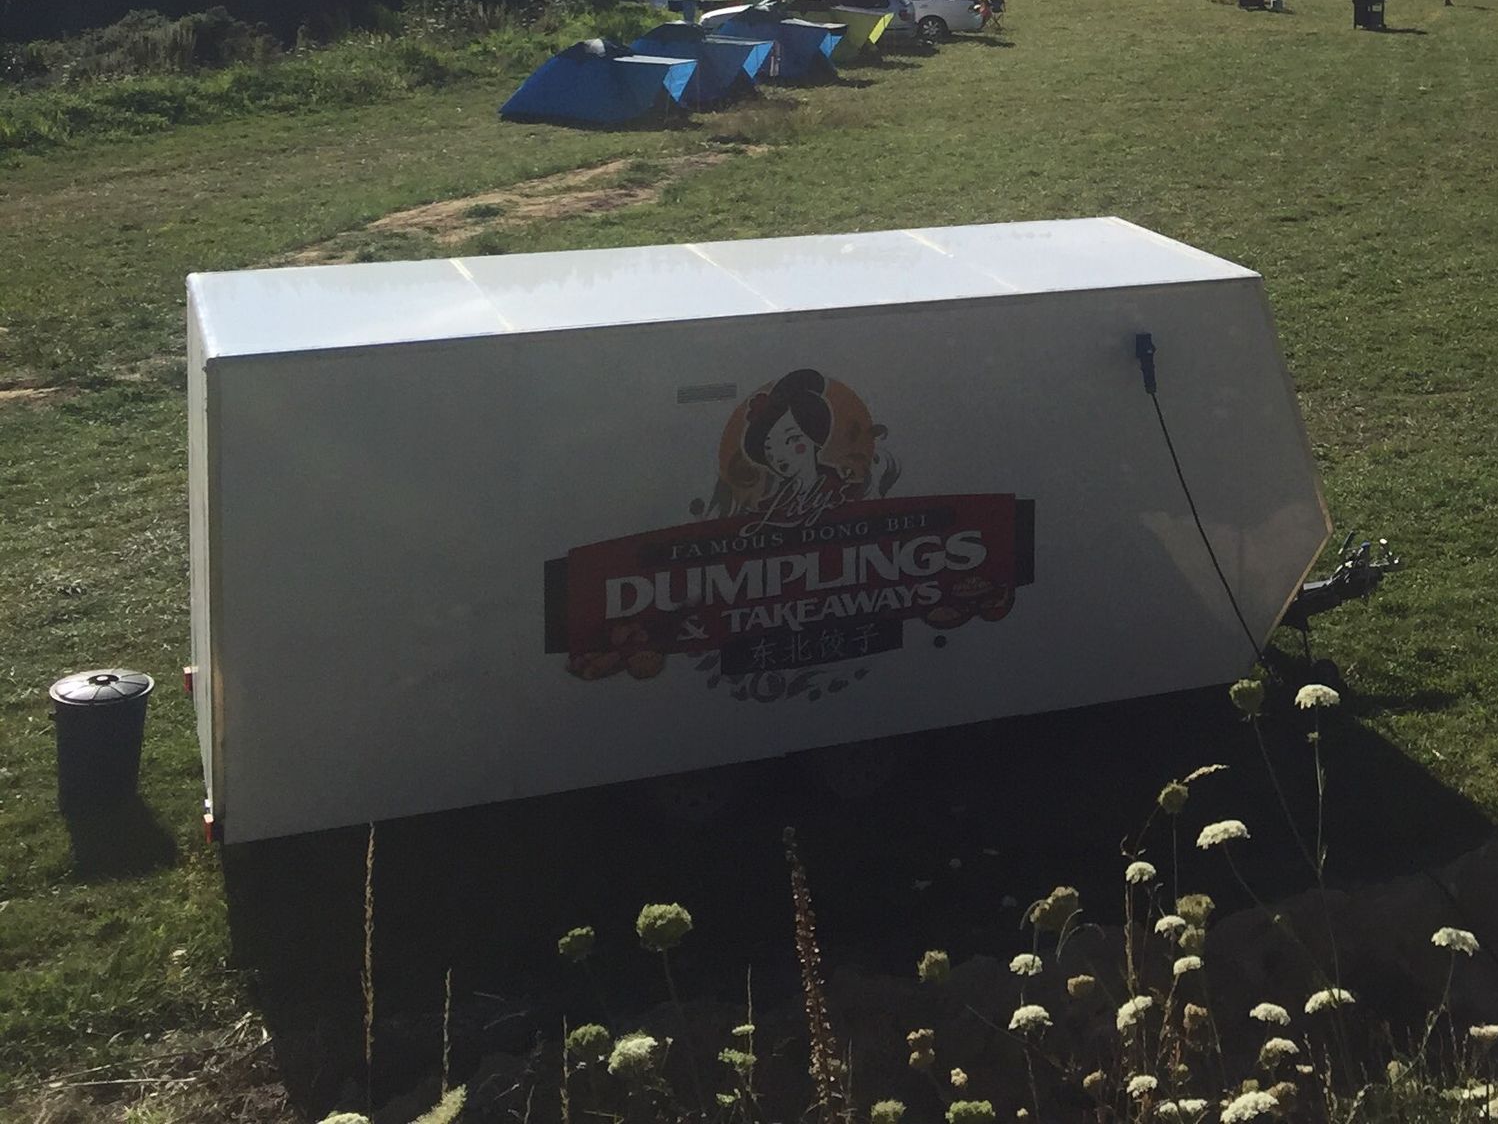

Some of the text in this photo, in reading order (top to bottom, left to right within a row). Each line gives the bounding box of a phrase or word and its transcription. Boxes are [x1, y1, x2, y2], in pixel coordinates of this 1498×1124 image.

[669, 514, 929, 560] FAMOUS DONG BEI
[604, 530, 988, 620] DUMPLINGS
[677, 580, 944, 642] & TAKEAWAYS
